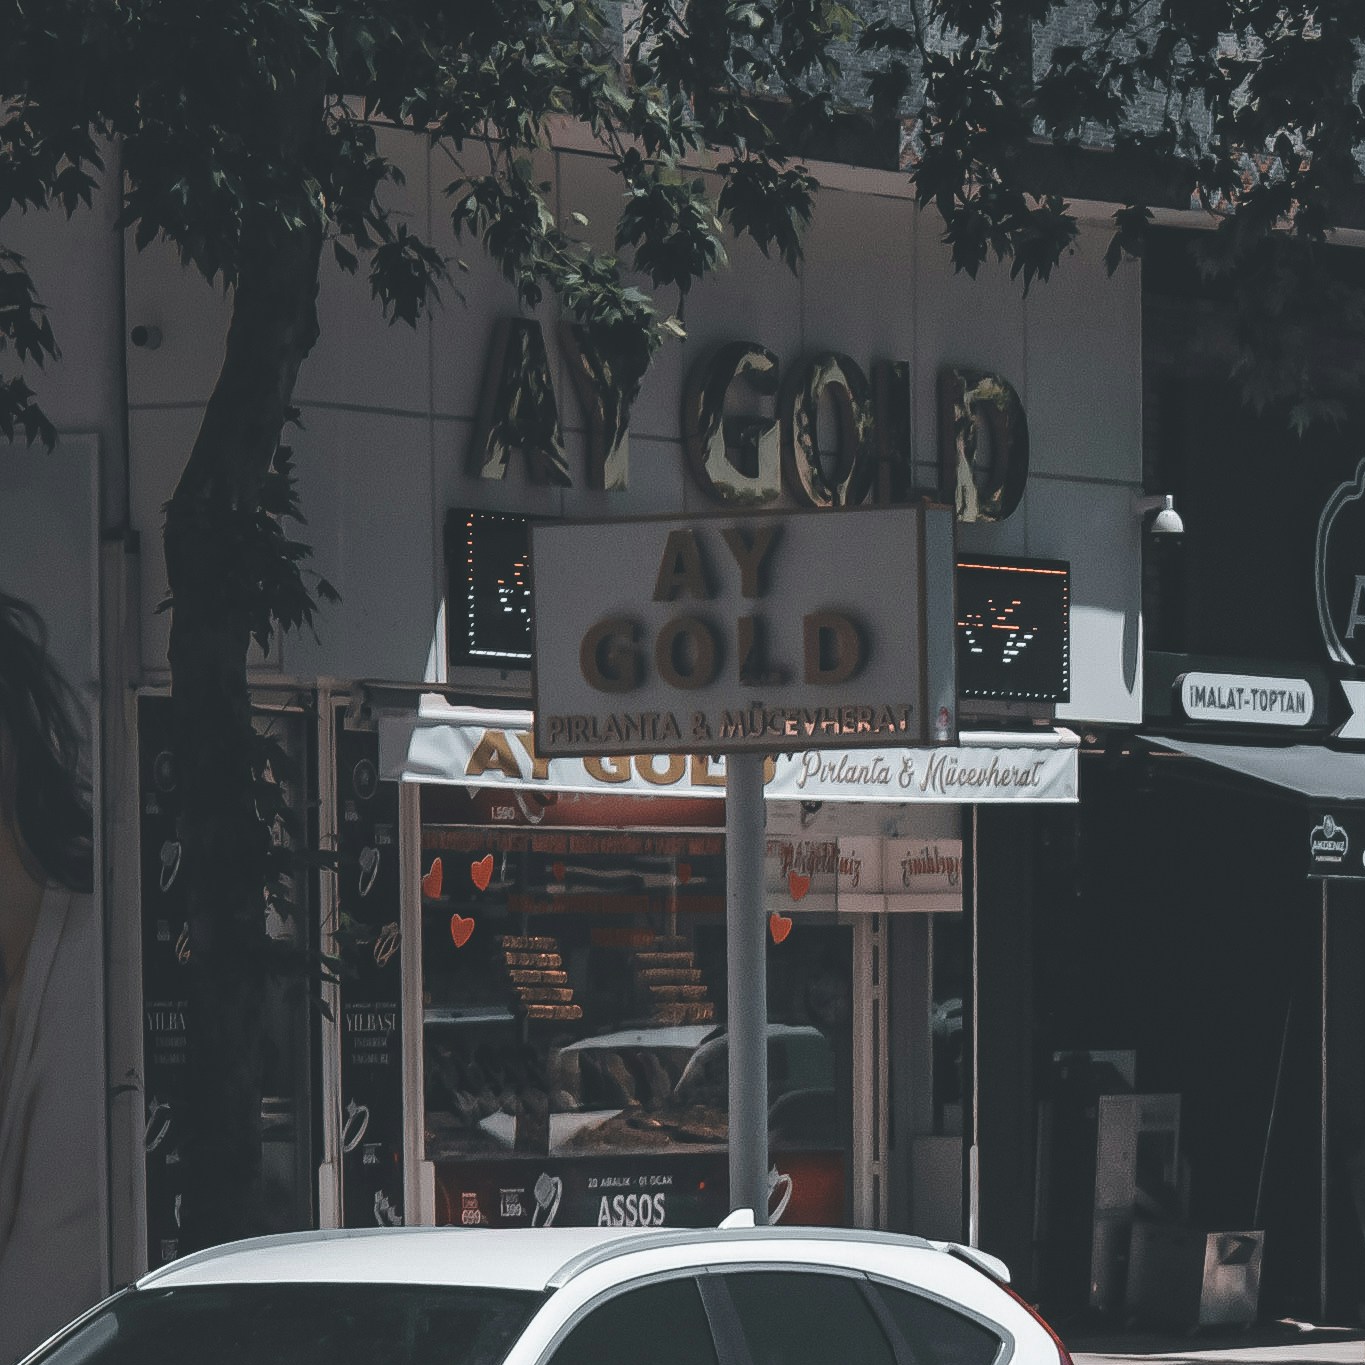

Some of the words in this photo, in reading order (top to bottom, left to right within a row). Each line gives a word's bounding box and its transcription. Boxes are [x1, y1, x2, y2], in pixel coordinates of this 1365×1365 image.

[477, 316, 652, 490] AY
[692, 338, 1030, 522] GOLD
[652, 526, 778, 602] AY
[578, 611, 862, 694] GOLD
[692, 711, 711, 742] &
[719, 702, 913, 740] MÜCEVHERAT
[898, 756, 915, 789] &
[918, 752, 1046, 794] Mücevherat
[147, 1011, 187, 1032] YILBA
[597, 1192, 666, 1227] ASSOS
